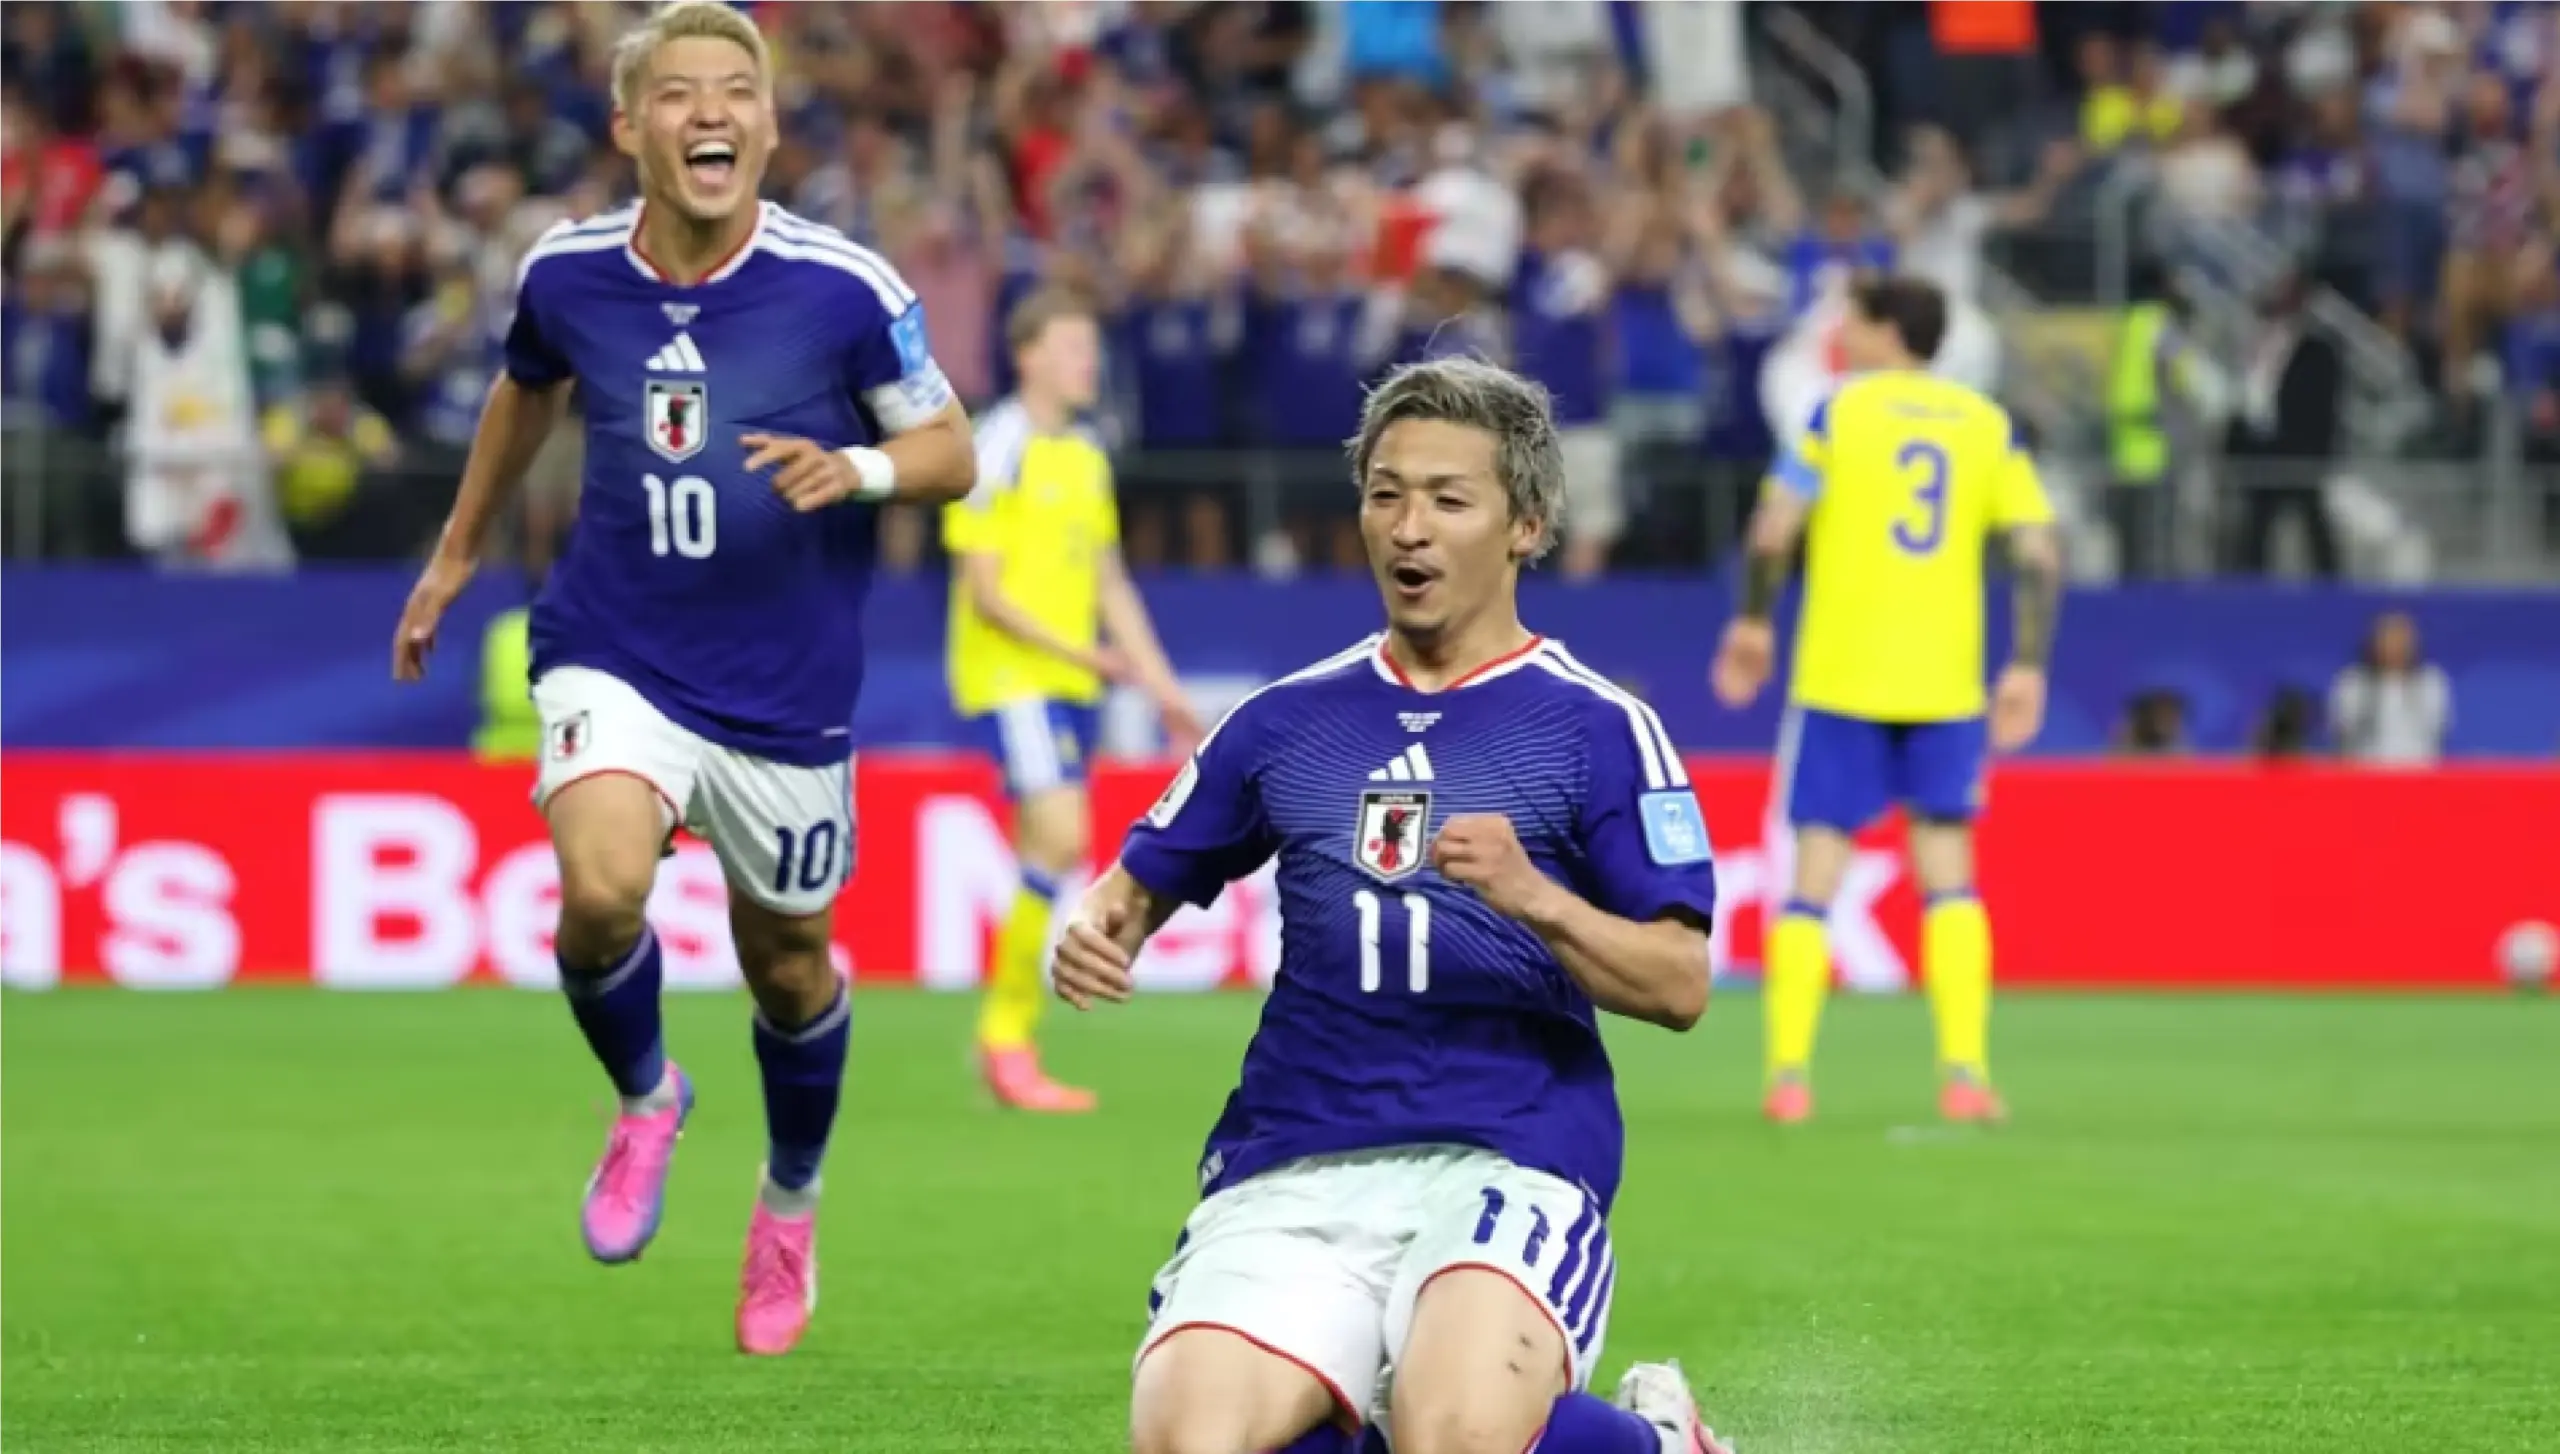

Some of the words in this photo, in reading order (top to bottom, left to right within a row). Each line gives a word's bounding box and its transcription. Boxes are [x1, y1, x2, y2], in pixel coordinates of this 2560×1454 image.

[642, 473, 717, 558] 10
[1891, 440, 1950, 556] 3
[309, 790, 856, 990] Bes
[775, 818, 837, 894] 10
[1353, 889, 1430, 993] 11
[1472, 1187, 1550, 1268] 11
